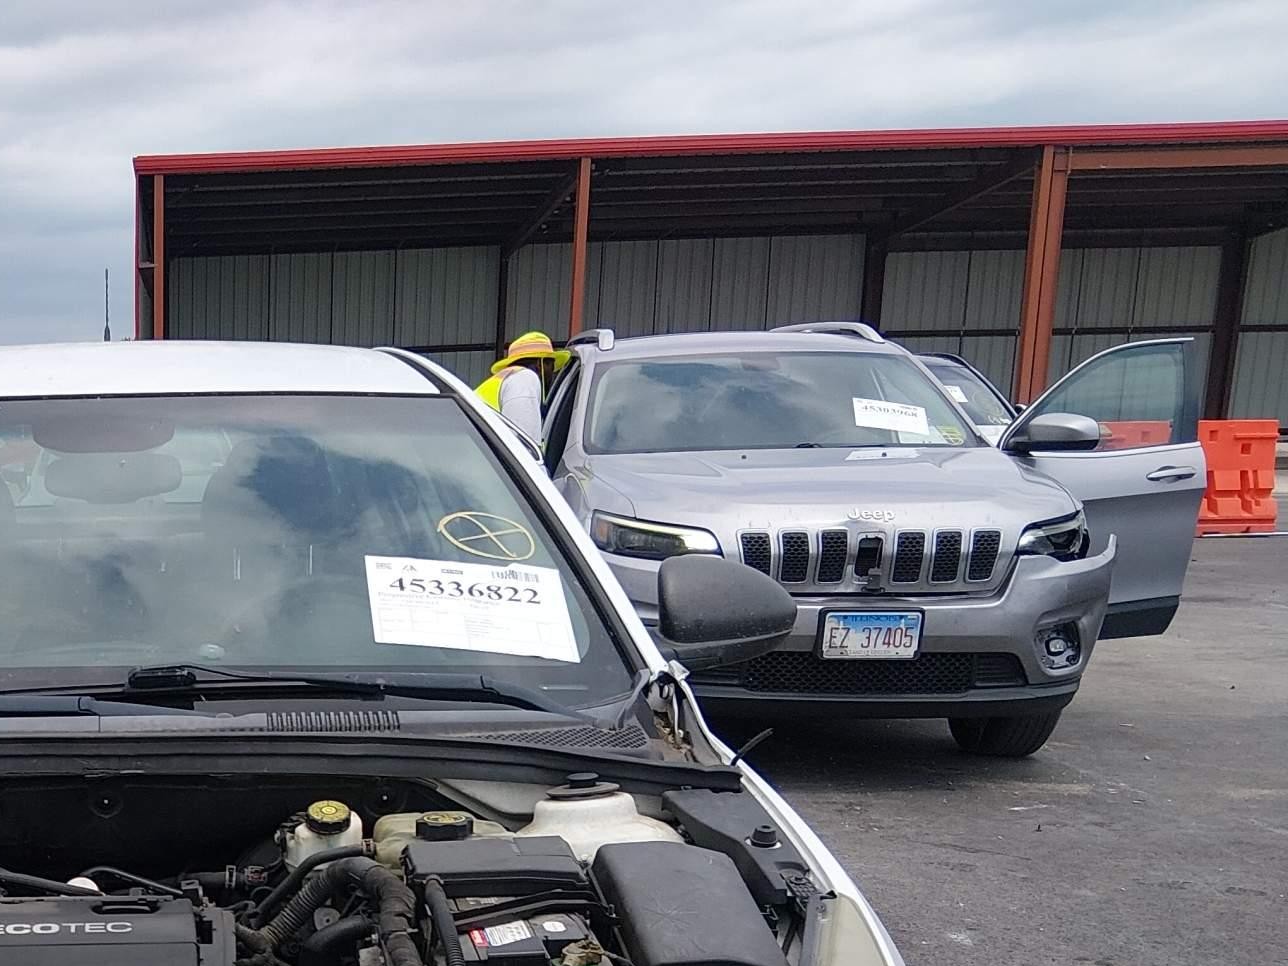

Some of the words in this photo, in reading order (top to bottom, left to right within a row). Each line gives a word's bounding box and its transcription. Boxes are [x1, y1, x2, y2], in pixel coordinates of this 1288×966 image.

[847, 507, 895, 524] Jeep
[389, 577, 541, 605] 45336822
[829, 626, 850, 648] EZ
[861, 626, 914, 648] 37405
